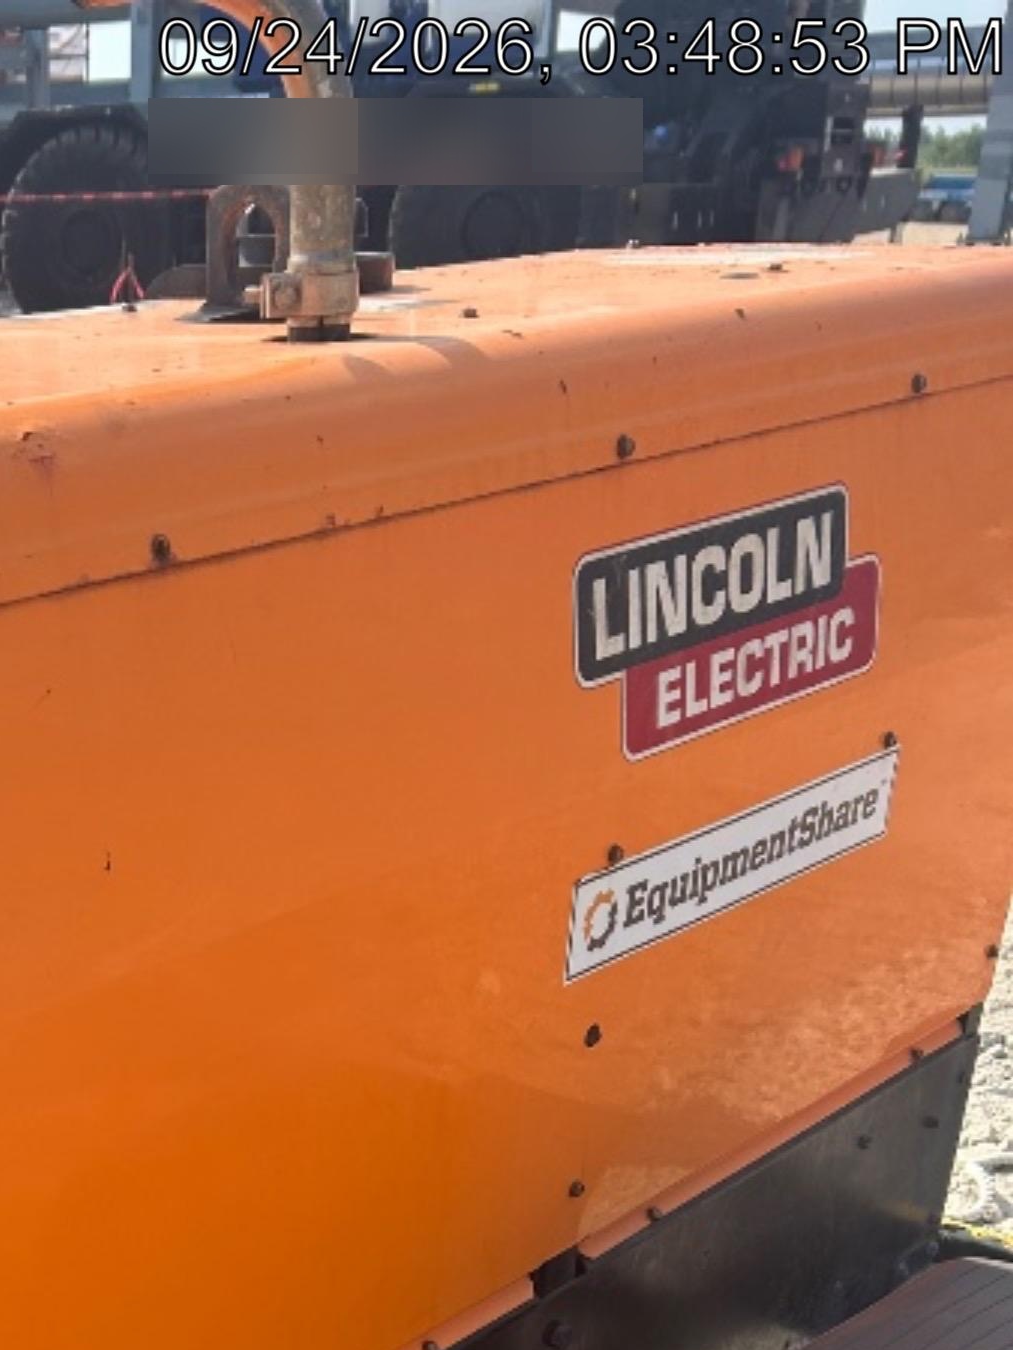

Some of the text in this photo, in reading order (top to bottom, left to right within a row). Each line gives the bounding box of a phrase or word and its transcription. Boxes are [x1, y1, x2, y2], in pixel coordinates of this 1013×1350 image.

[592, 511, 834, 662] LINCOLN
[655, 607, 855, 729] ELECTRIC
[623, 786, 880, 928] EquipmentShare
